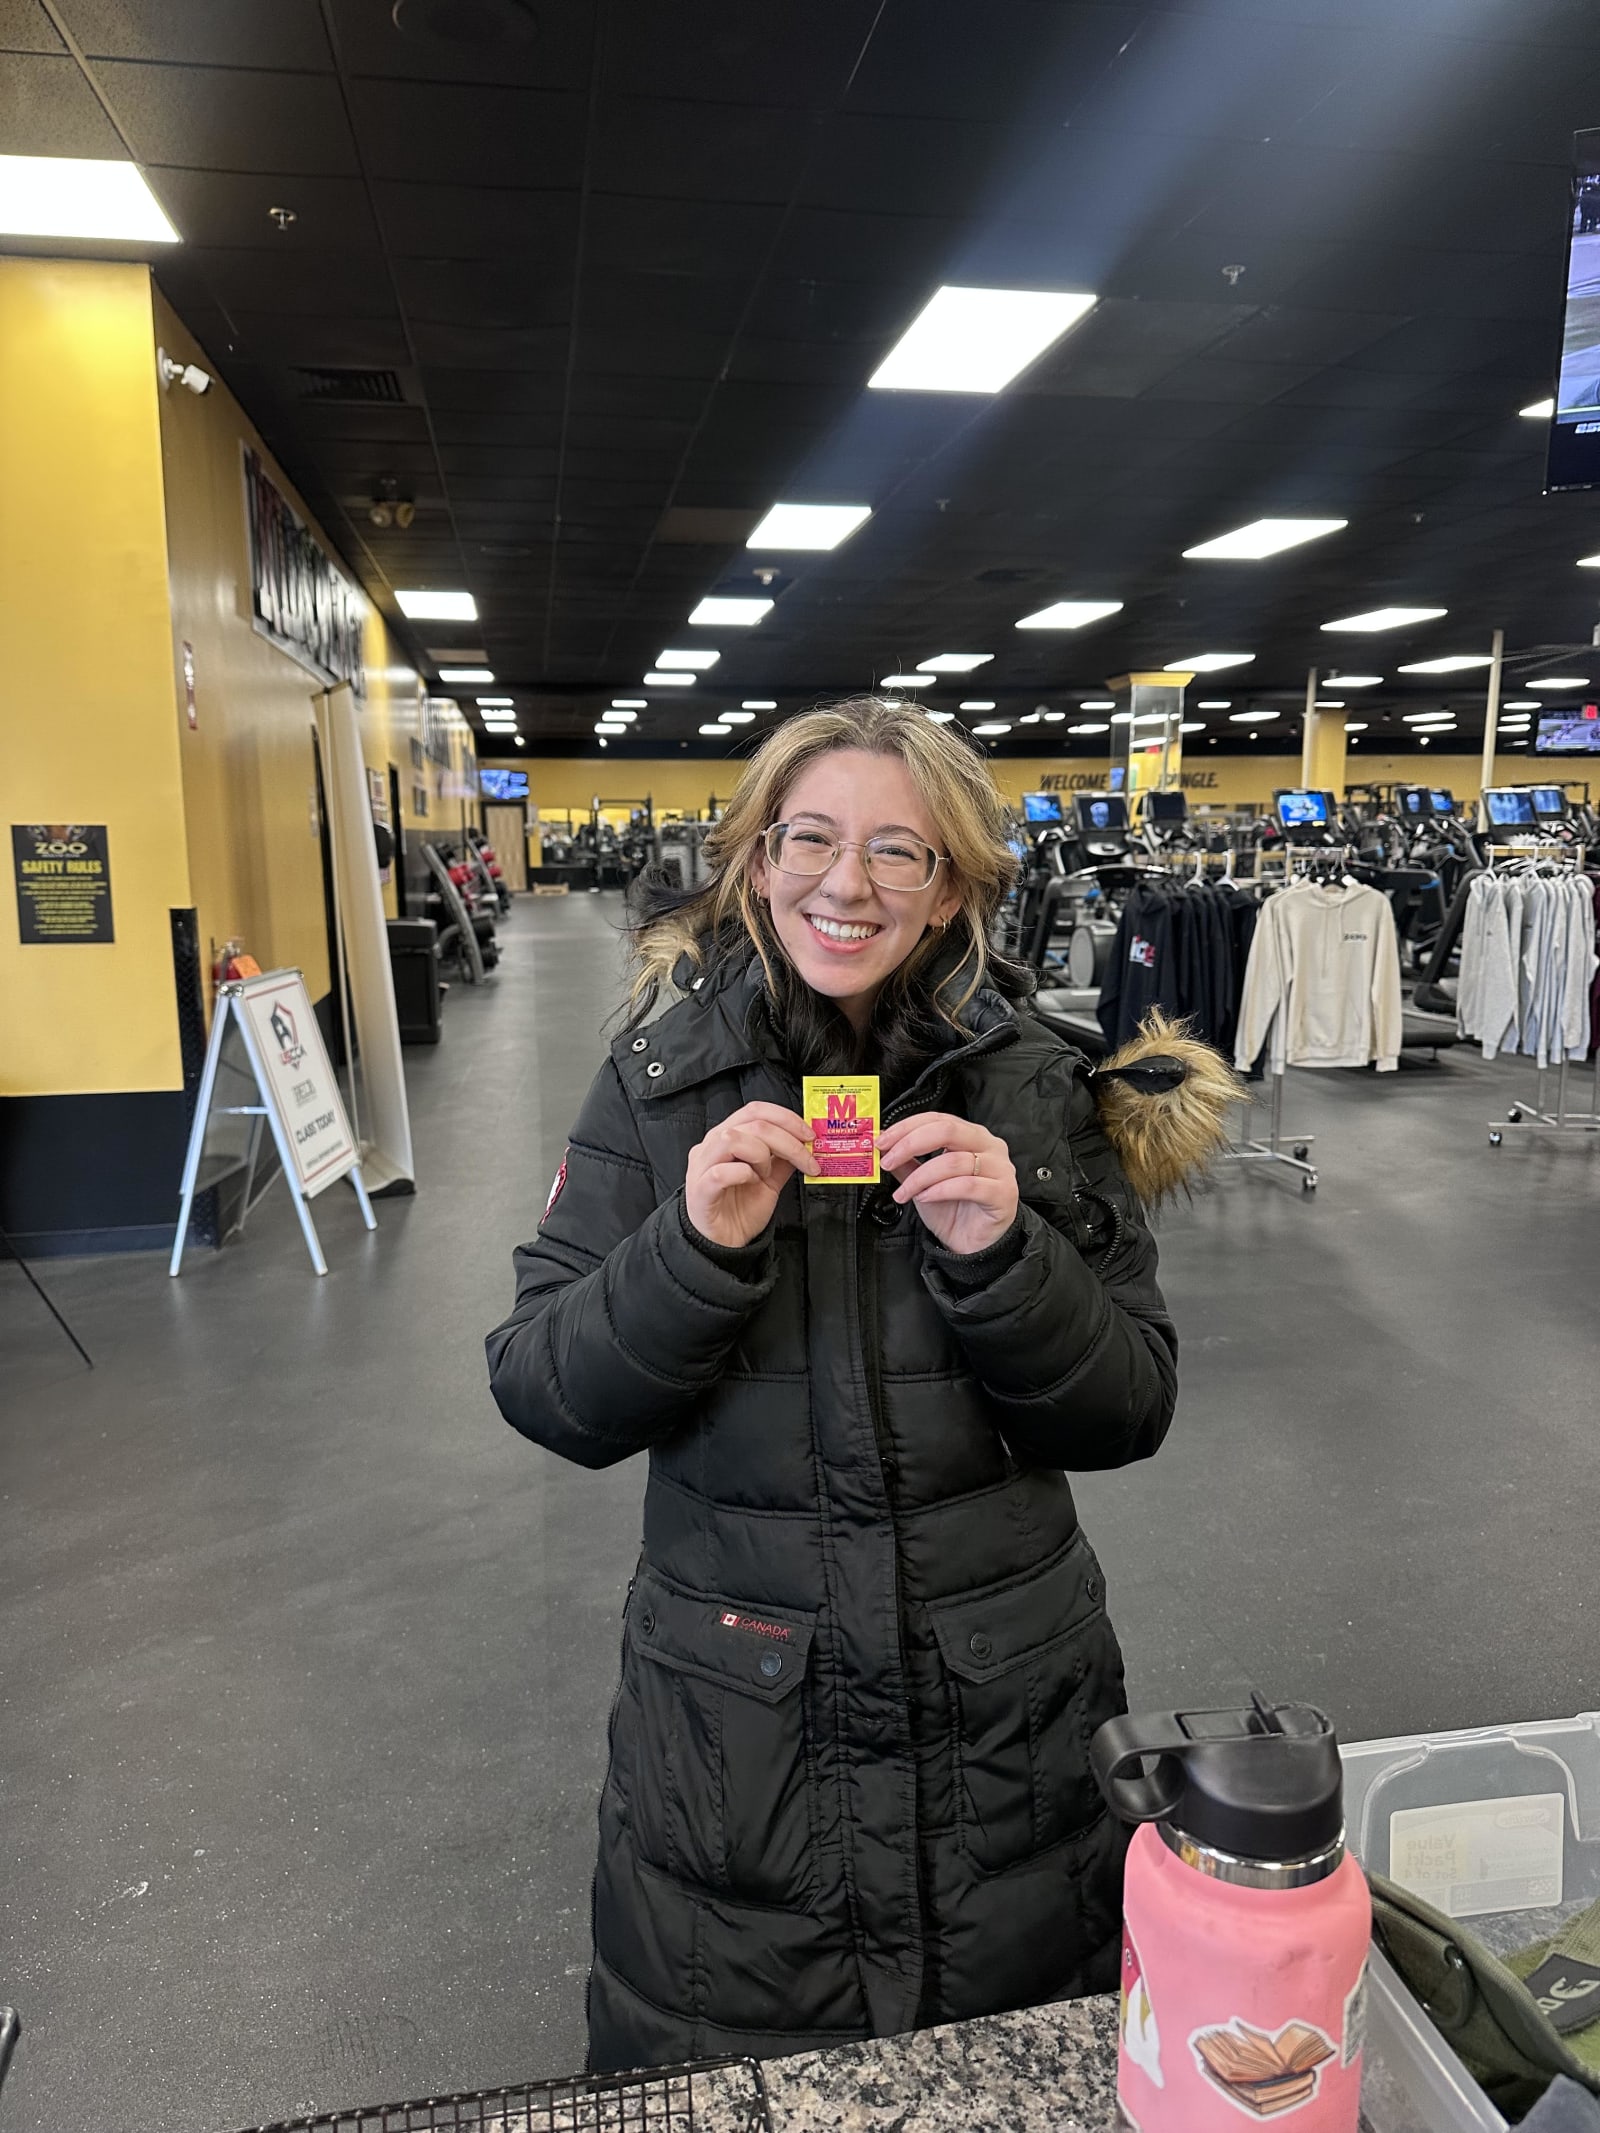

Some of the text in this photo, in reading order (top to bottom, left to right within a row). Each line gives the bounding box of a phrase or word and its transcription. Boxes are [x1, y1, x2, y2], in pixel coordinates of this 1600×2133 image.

[1040, 772, 1108, 790] WELCOME
[34, 841, 88, 854] ZOO
[281, 1044, 307, 1064] USCCA
[828, 1095, 857, 1119] M
[296, 1110, 336, 1143] CLASS TODAY
[741, 1617, 789, 1638] CANADA
